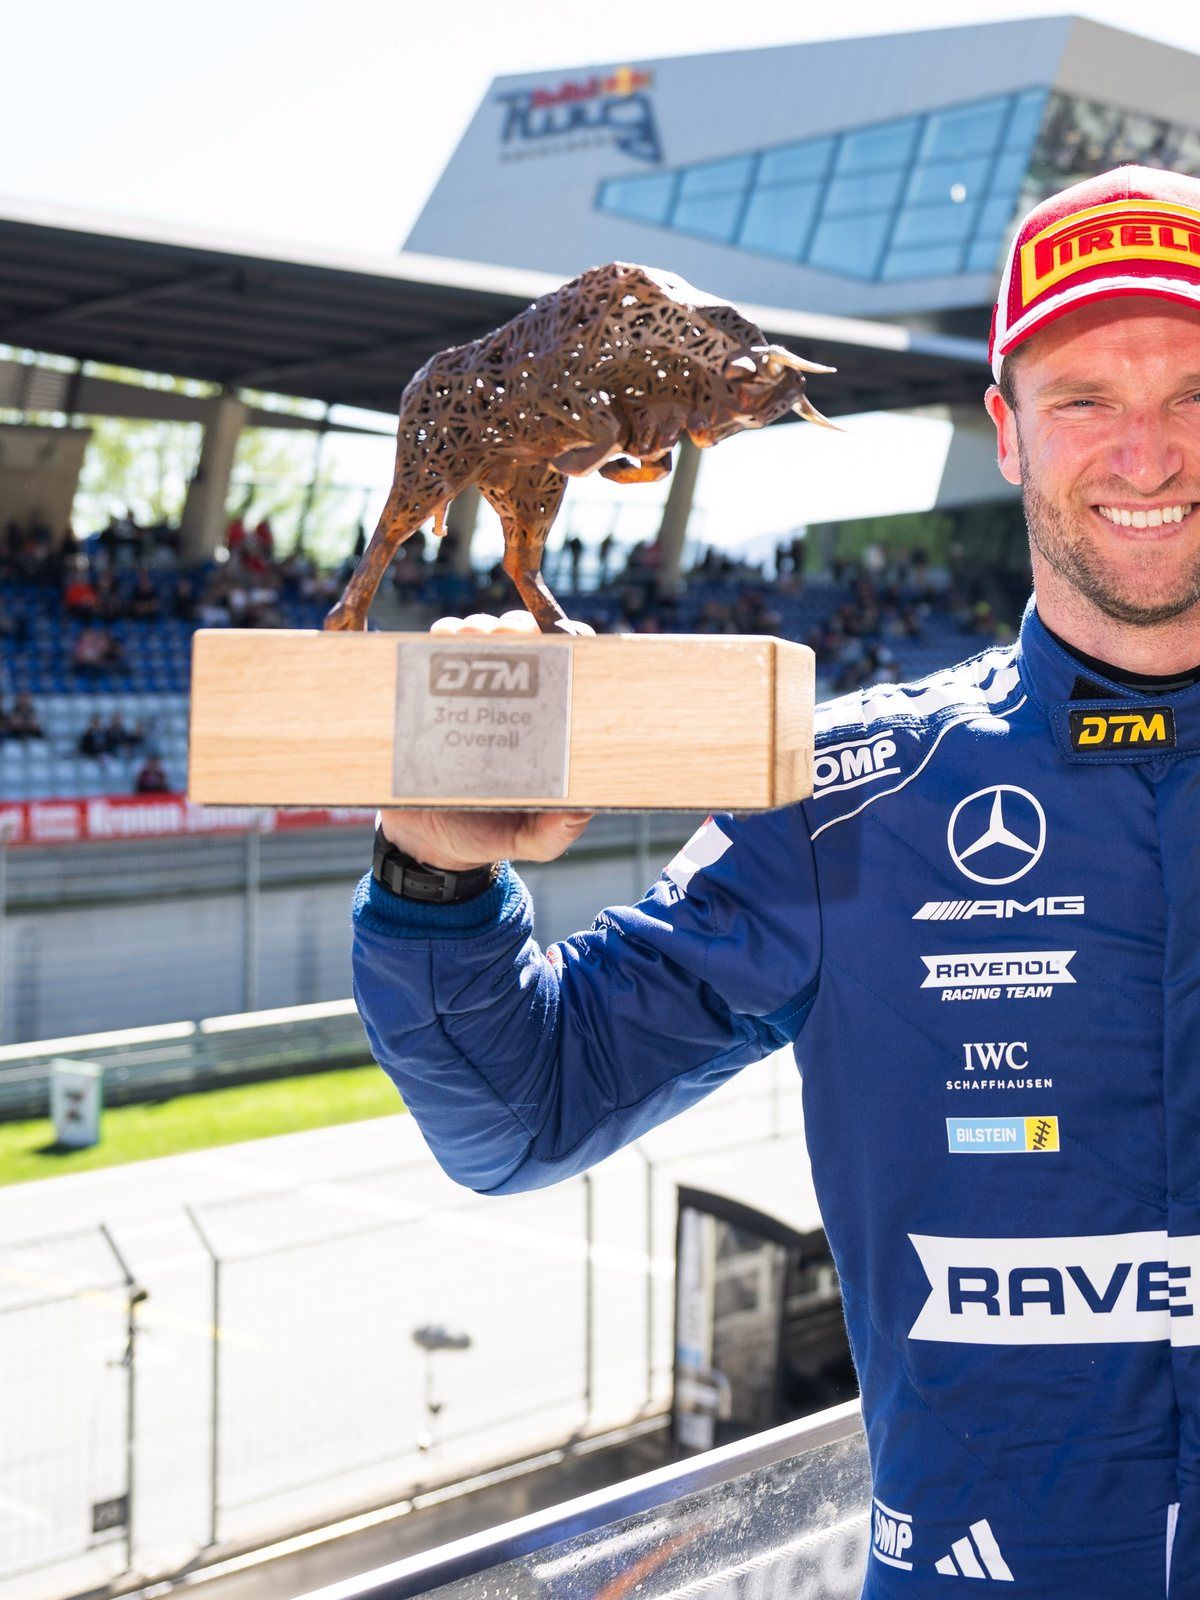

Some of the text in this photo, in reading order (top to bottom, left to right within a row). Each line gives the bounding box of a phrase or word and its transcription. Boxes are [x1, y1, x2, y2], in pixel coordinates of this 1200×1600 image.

[436, 660, 530, 691] DTM
[434, 706, 533, 725] 3rd Place
[1079, 714, 1166, 745] DTM
[445, 731, 520, 748] Overall
[814, 740, 897, 786] OMP
[961, 896, 1085, 920] AMG
[936, 960, 1060, 979] RAVENOL
[941, 986, 1053, 1001] RACING TEAM
[962, 1041, 1029, 1071] IWC
[946, 1078, 1053, 1090] SCHAFFHAUSEN
[956, 1127, 1017, 1143] BILSTEIN
